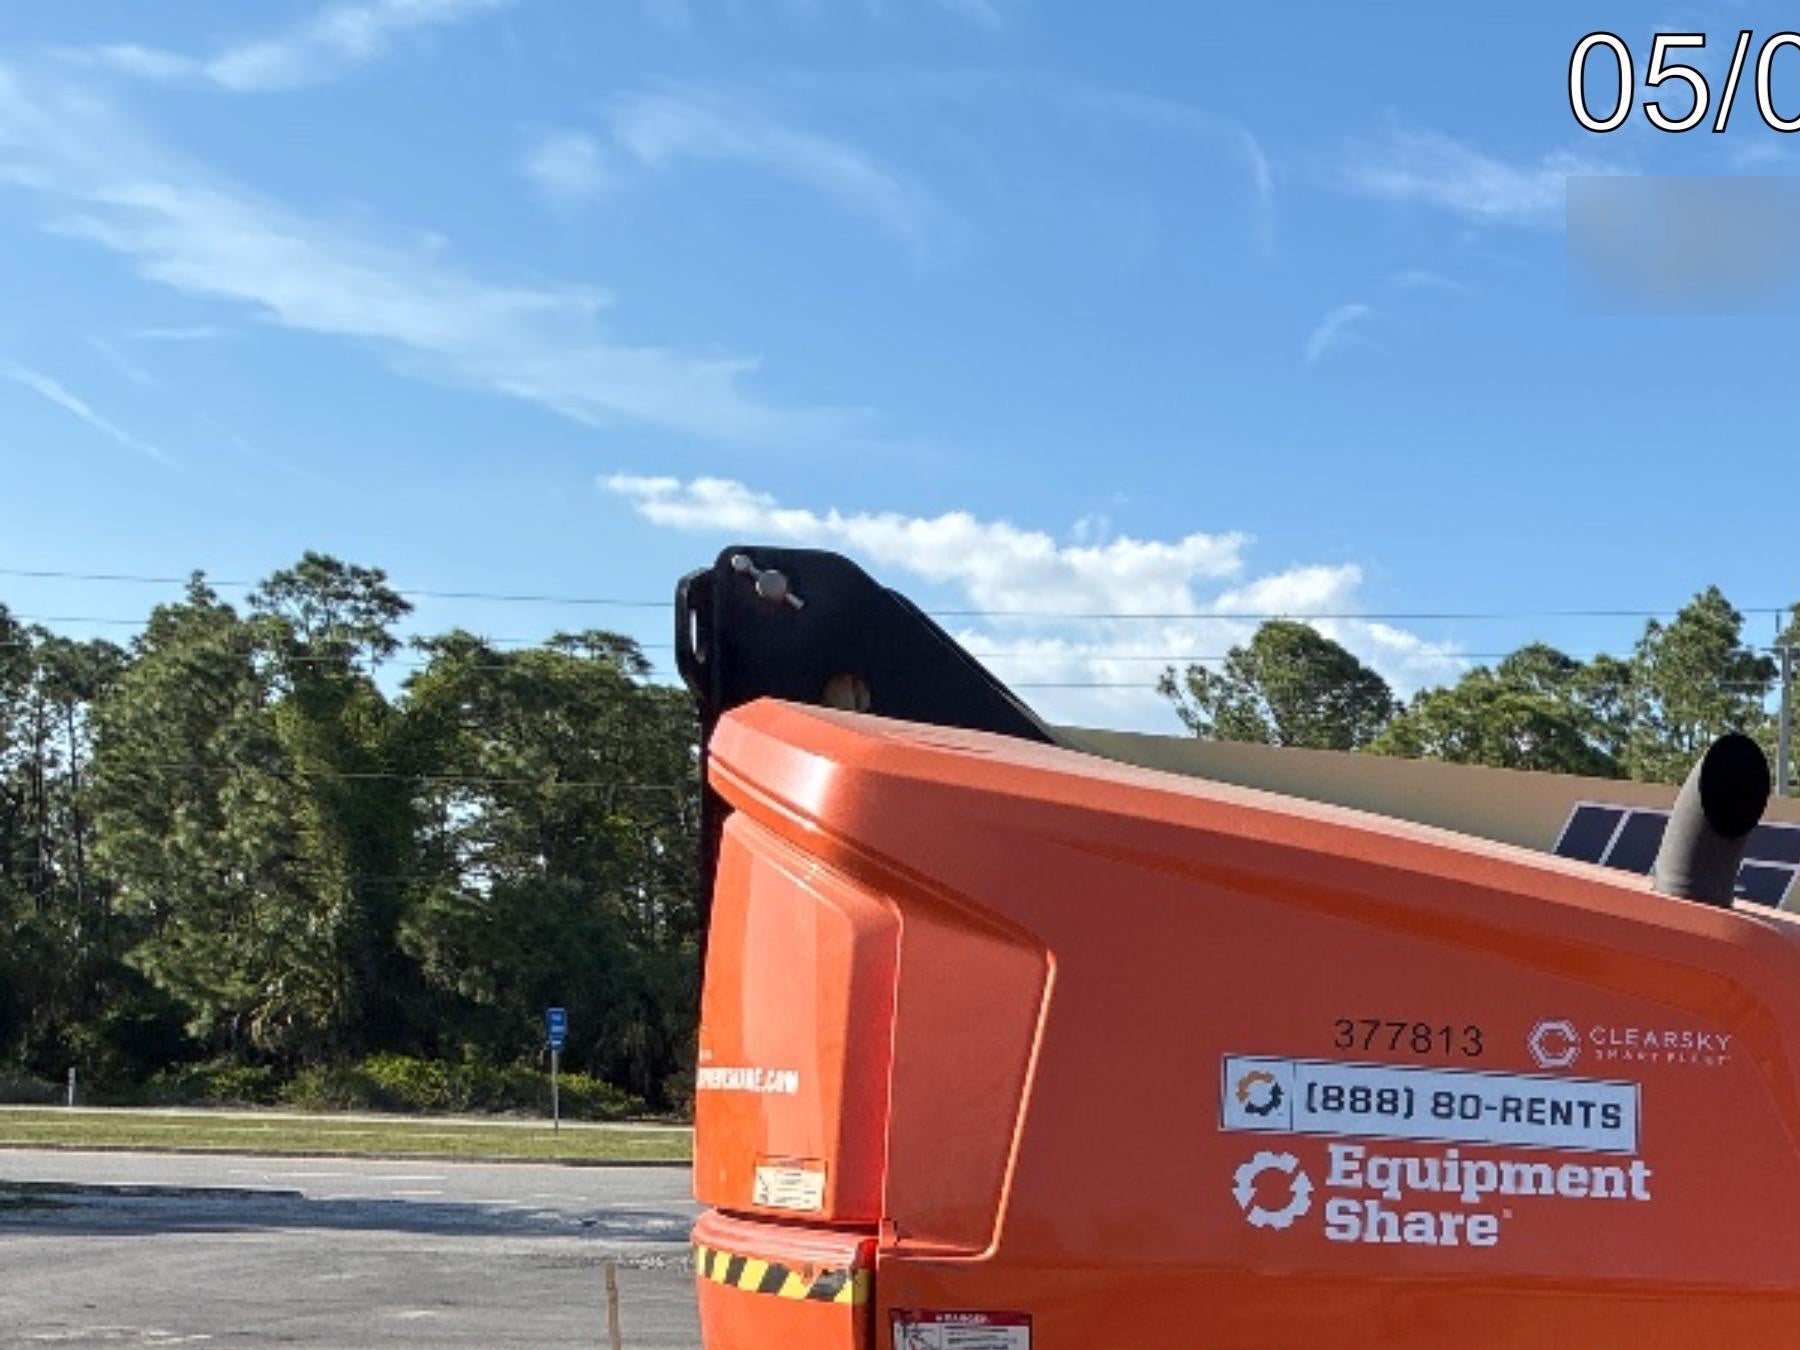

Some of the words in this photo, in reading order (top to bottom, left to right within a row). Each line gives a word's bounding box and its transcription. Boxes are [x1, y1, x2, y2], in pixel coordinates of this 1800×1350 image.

[1333, 1019, 1484, 1057] 377813
[1588, 1025, 1732, 1051] CLEARSKY
[1306, 1082, 1415, 1119] (888)
[1430, 1091, 1623, 1130] 80-RENTS
[1324, 1143, 1651, 1203] Equipment
[1324, 1197, 1502, 1247] Share
